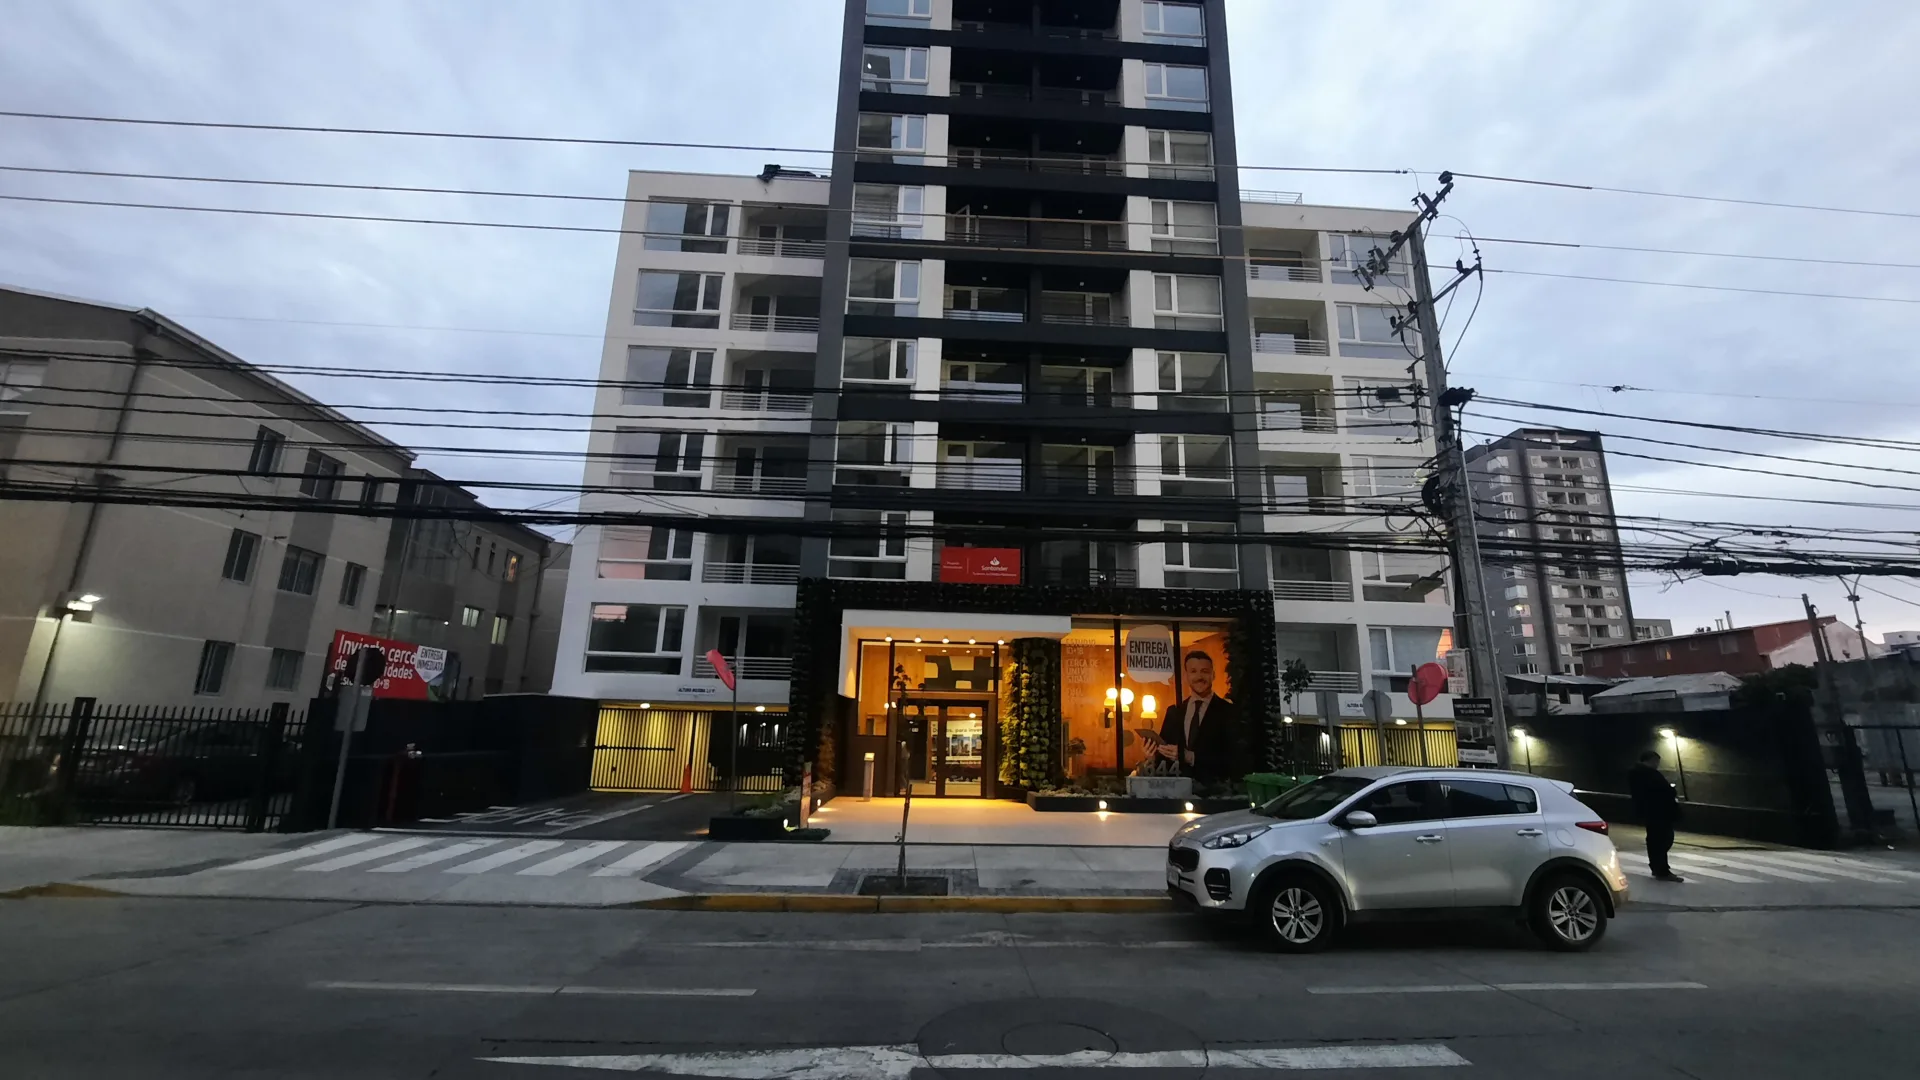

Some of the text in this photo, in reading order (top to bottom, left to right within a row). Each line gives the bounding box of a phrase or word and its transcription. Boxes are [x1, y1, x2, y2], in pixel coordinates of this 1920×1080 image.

[1129, 640, 1169, 655] ENTREGA
[334, 655, 348, 671] de
[388, 647, 417, 665] cerca
[1067, 659, 1099, 668] CERCA DE
[1126, 655, 1172, 669] INMEDIATA
